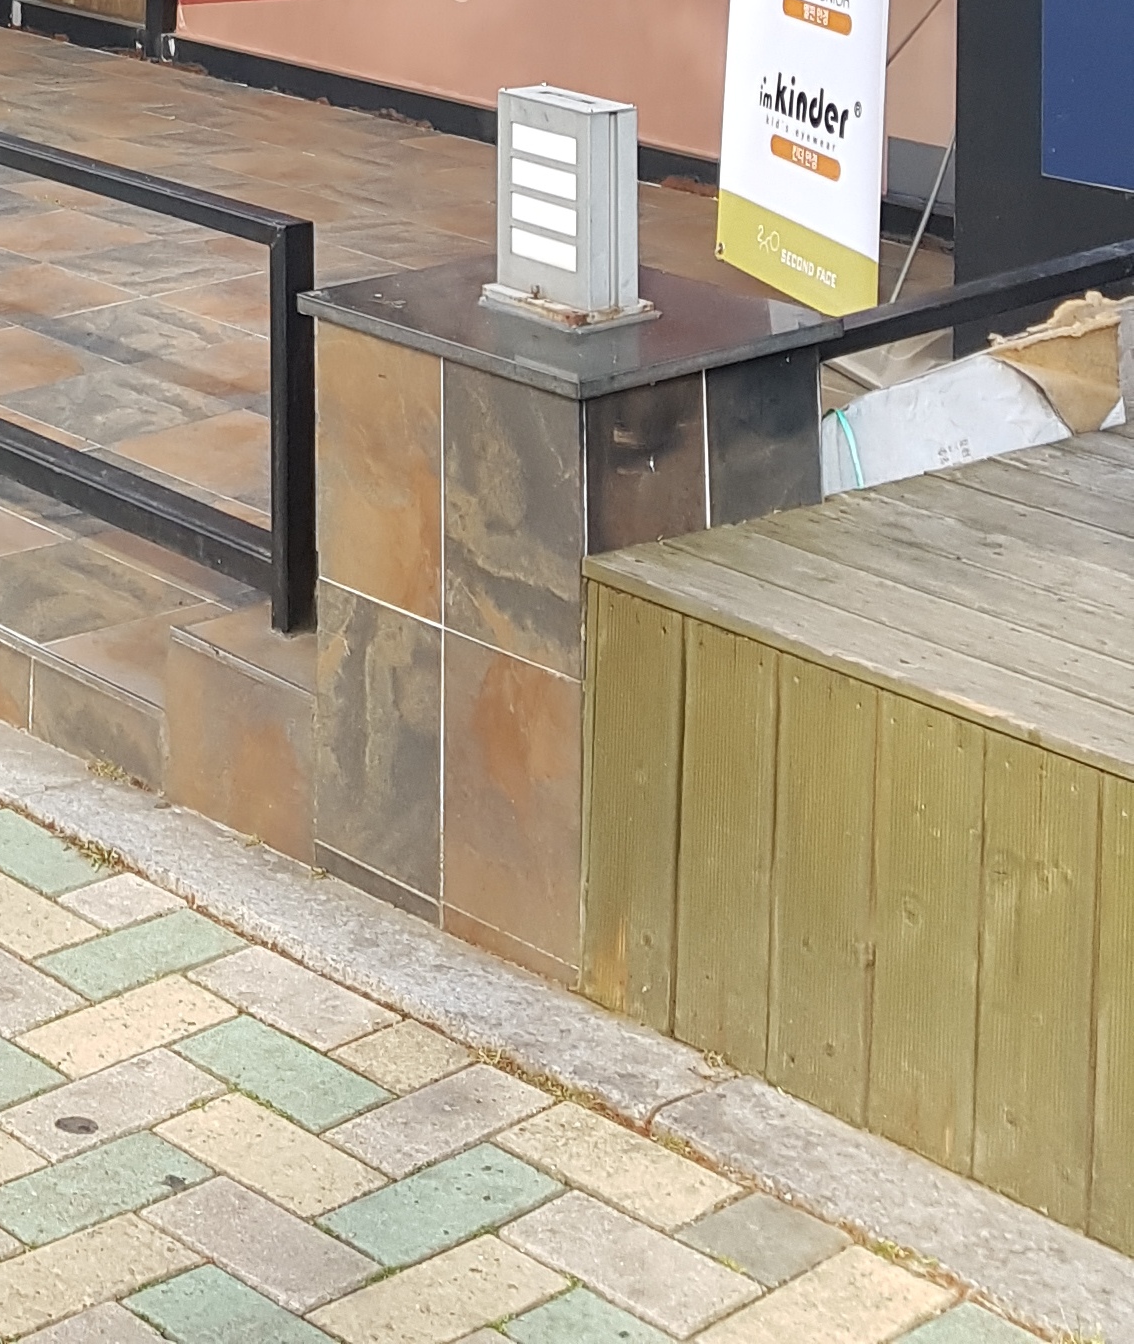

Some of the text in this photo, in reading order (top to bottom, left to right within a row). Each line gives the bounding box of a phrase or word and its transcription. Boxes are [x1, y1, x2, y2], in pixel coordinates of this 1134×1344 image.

[795, 128, 837, 152] eyewear
[780, 248, 837, 289] SECOND FACE
